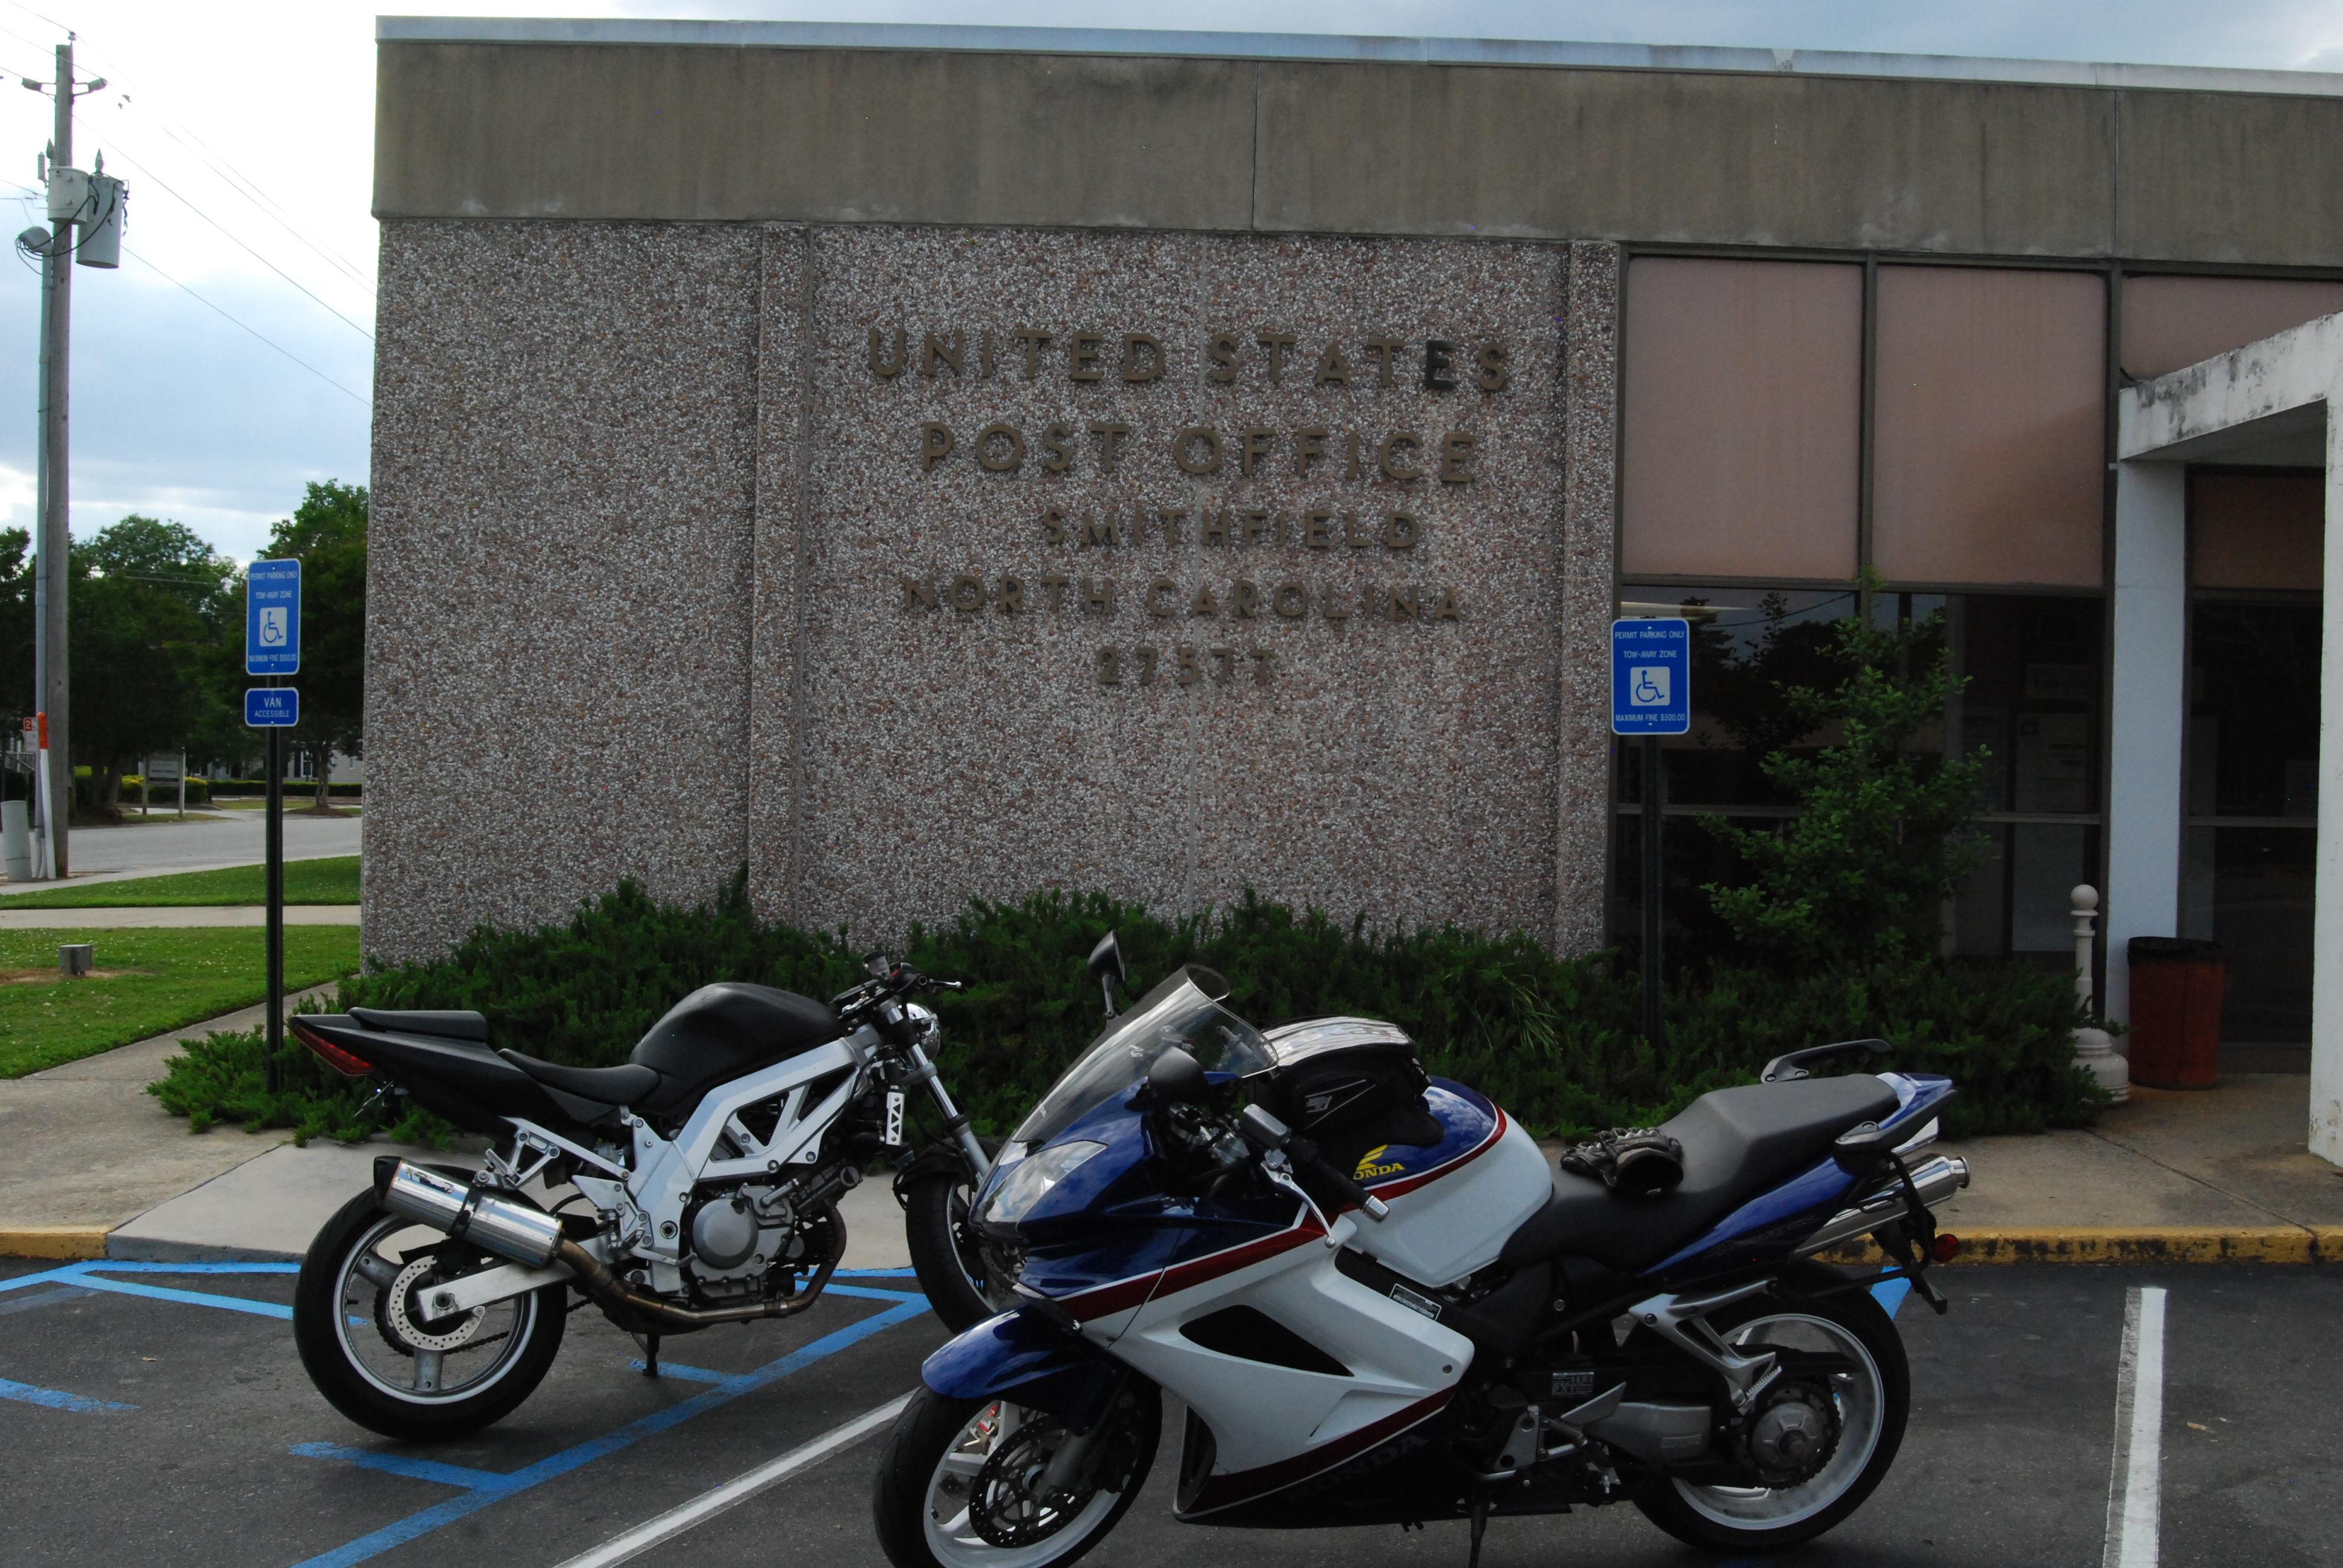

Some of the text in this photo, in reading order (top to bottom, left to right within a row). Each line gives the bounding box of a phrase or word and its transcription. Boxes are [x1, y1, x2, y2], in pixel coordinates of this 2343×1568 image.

[869, 327, 1506, 390] UNITED STATES
[922, 422, 1476, 482] POST OFFICE
[1043, 506, 1420, 548] SMITHFIELD
[250, 570, 297, 580] PERMIT PARKING ONLY
[255, 591, 278, 599] TOW-AWAY
[905, 574, 1462, 620] NORTH CAROLINA
[280, 653, 297, 662] $500.00
[1096, 645, 1274, 686] 27577
[264, 697, 281, 708] VAN
[254, 710, 289, 718] ACCESSIBLE
[1353, 1162, 1405, 1180] ONDA
